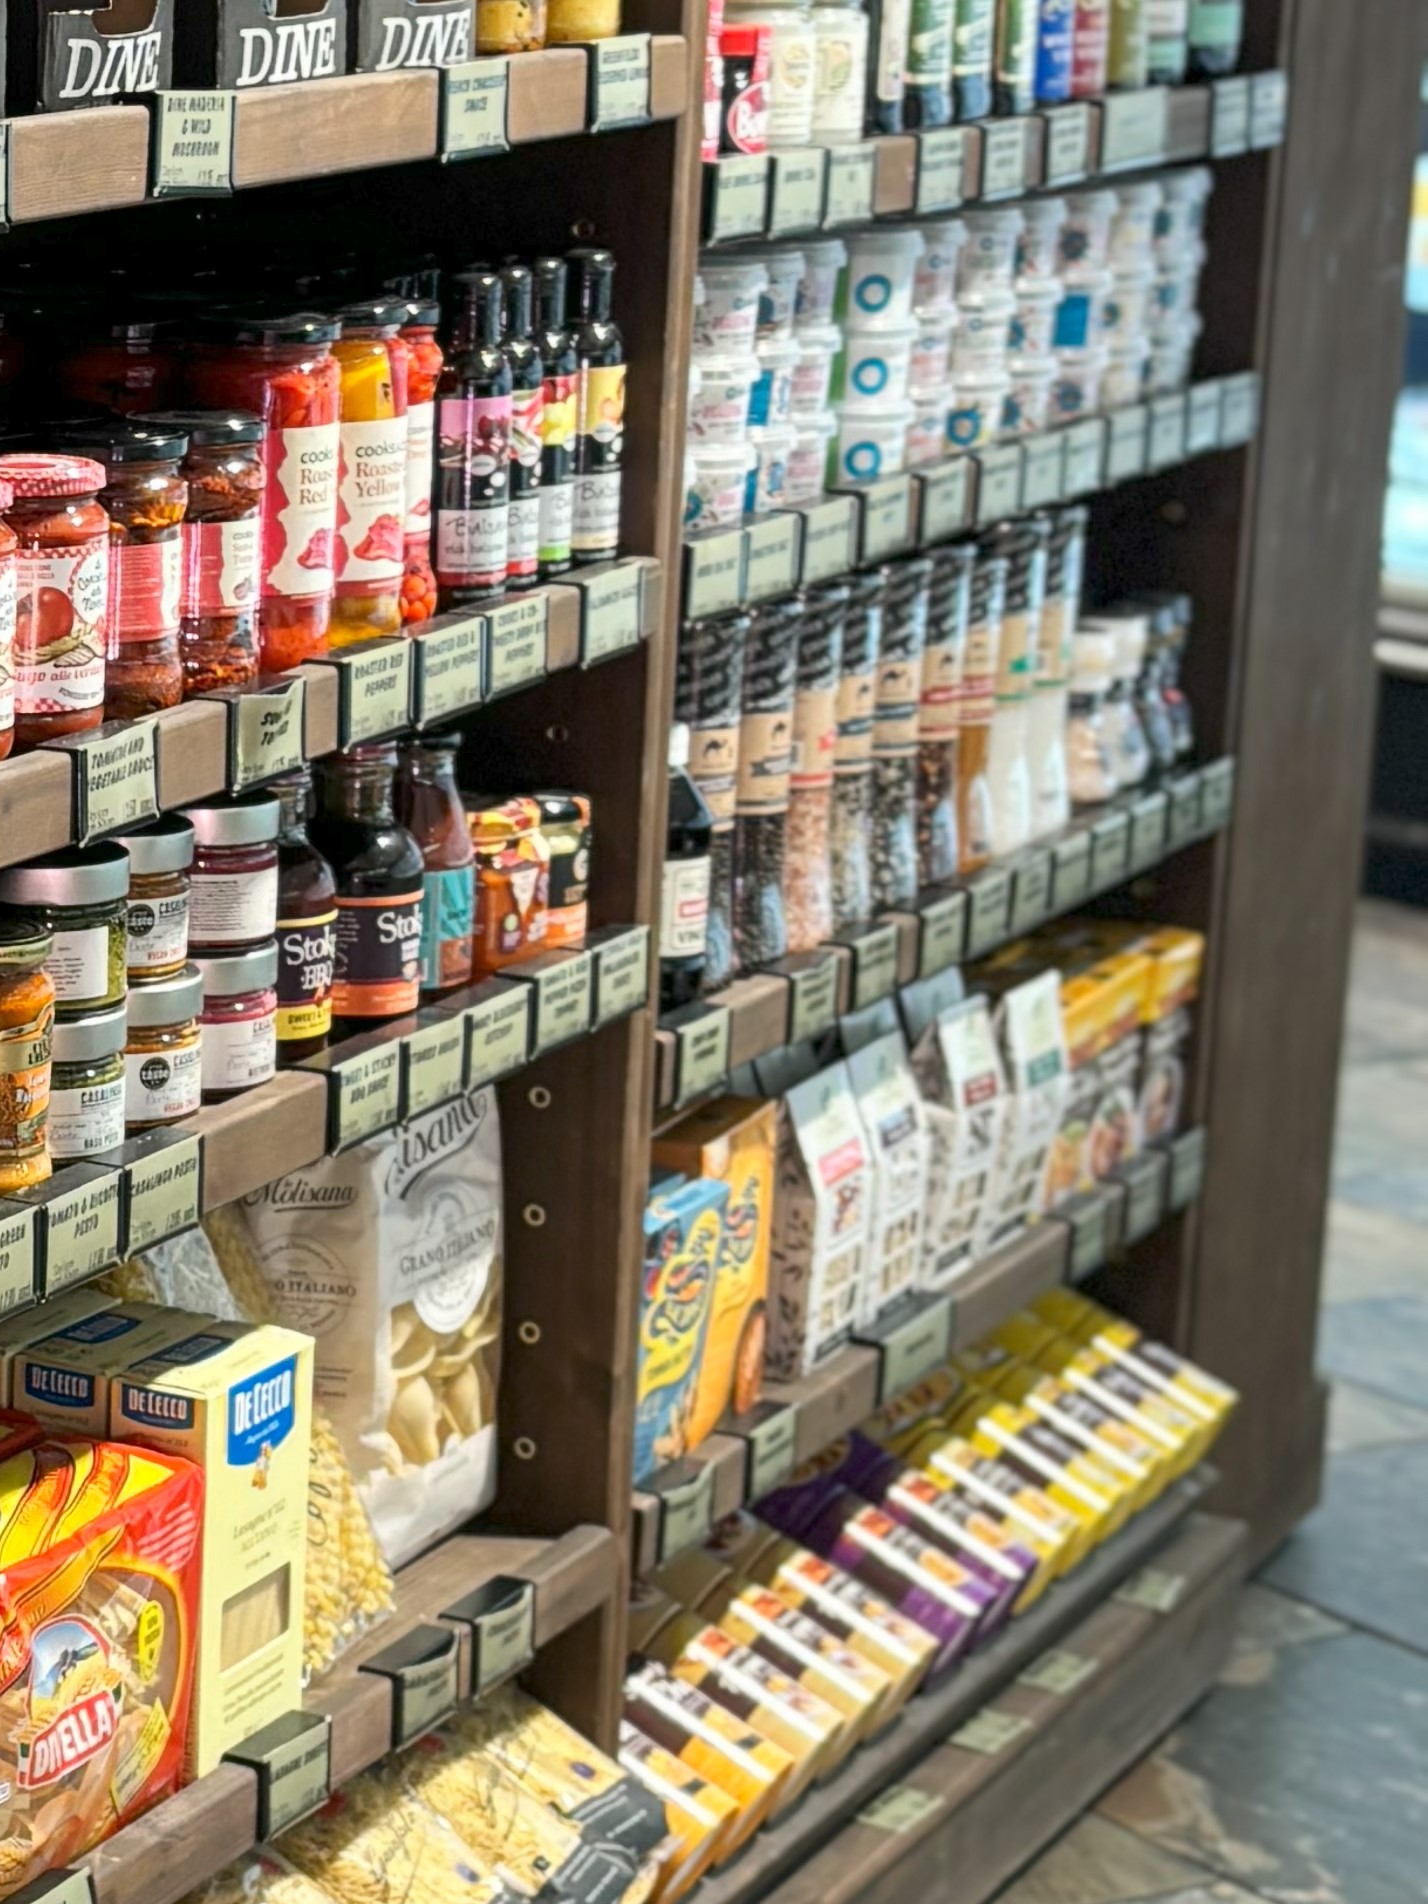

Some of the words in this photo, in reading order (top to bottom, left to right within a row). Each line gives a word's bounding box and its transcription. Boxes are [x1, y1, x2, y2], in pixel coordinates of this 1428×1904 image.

[59, 32, 161, 98] DINE
[236, 20, 337, 86] DINE
[375, 10, 469, 70] DINE
